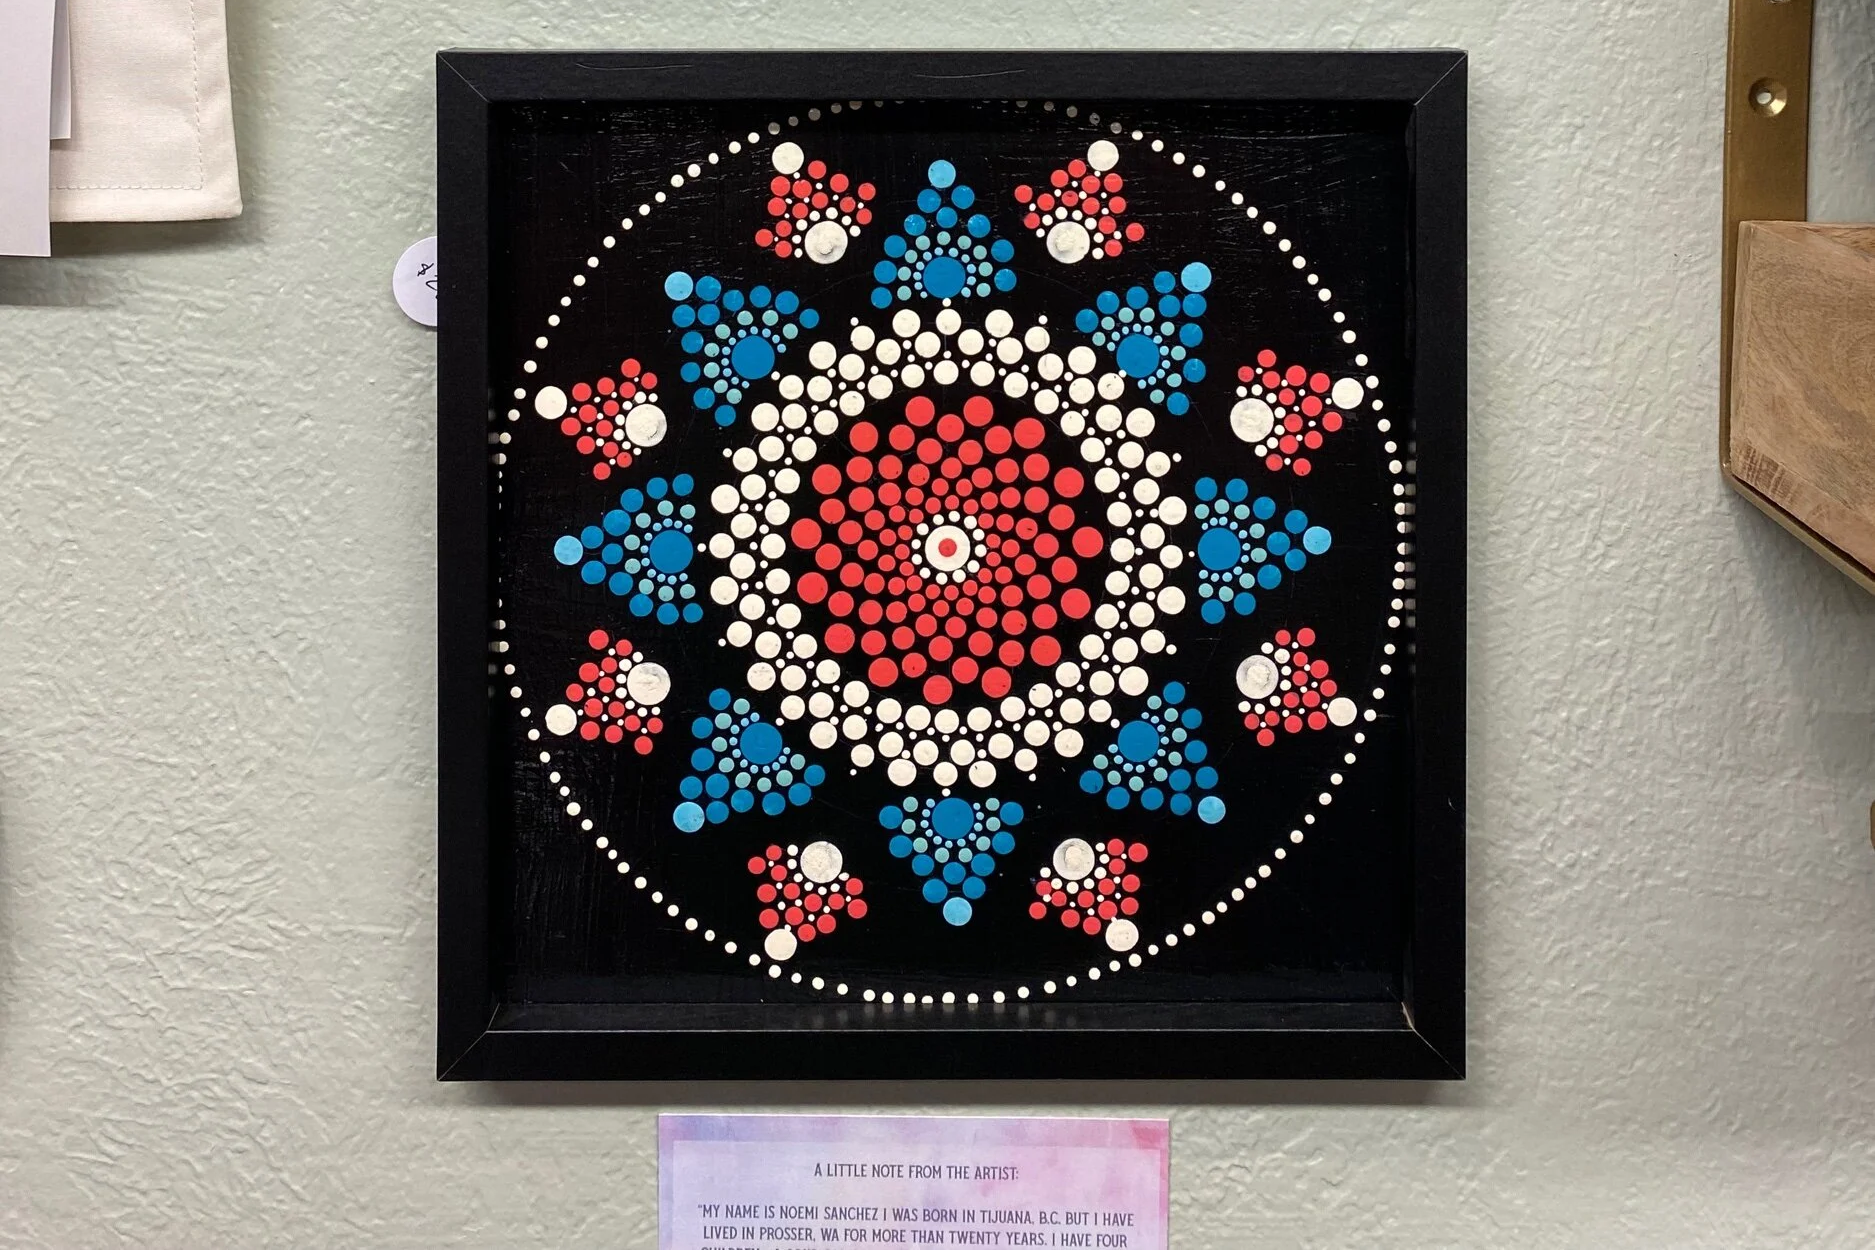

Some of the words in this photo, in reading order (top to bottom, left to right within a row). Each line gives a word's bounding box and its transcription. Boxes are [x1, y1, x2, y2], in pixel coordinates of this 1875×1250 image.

[814, 1162, 823, 1177] A
[827, 1163, 867, 1178] LITTLE
[872, 1164, 904, 1179] NOTE
[909, 1165, 941, 1180] FROM
[947, 1165, 970, 1180] THE
[974, 1166, 1019, 1181] ARTIST:
[725, 1204, 760, 1219] NAME
[764, 1205, 775, 1219] IS
[780, 1205, 818, 1220] NOEMI
[824, 1206, 878, 1221] SANCHEZ
[883, 1208, 887, 1221] I
[892, 1208, 919, 1222] WAS
[923, 1209, 958, 1223] BORN
[962, 1209, 976, 1224] IN
[1040, 1211, 1061, 1225] B.C.
[1065, 1212, 1090, 1226] BUT
[1094, 1212, 1098, 1226] I
[1103, 1213, 1135, 1227] HAVE
[703, 1225, 738, 1240] LIVED
[742, 1226, 755, 1240] IN
[759, 1227, 816, 1243] PROSSER,
[820, 1228, 840, 1242] WA
[844, 1228, 867, 1242] FOR
[872, 1228, 906, 1243] MORE
[911, 1230, 944, 1244] THAN
[949, 1231, 1000, 1245] TWENTY
[1006, 1232, 1047, 1246] YEARS.
[1052, 1233, 1056, 1247] I
[1061, 1233, 1092, 1247] HAVE
[1096, 1234, 1128, 1248] FOUR
